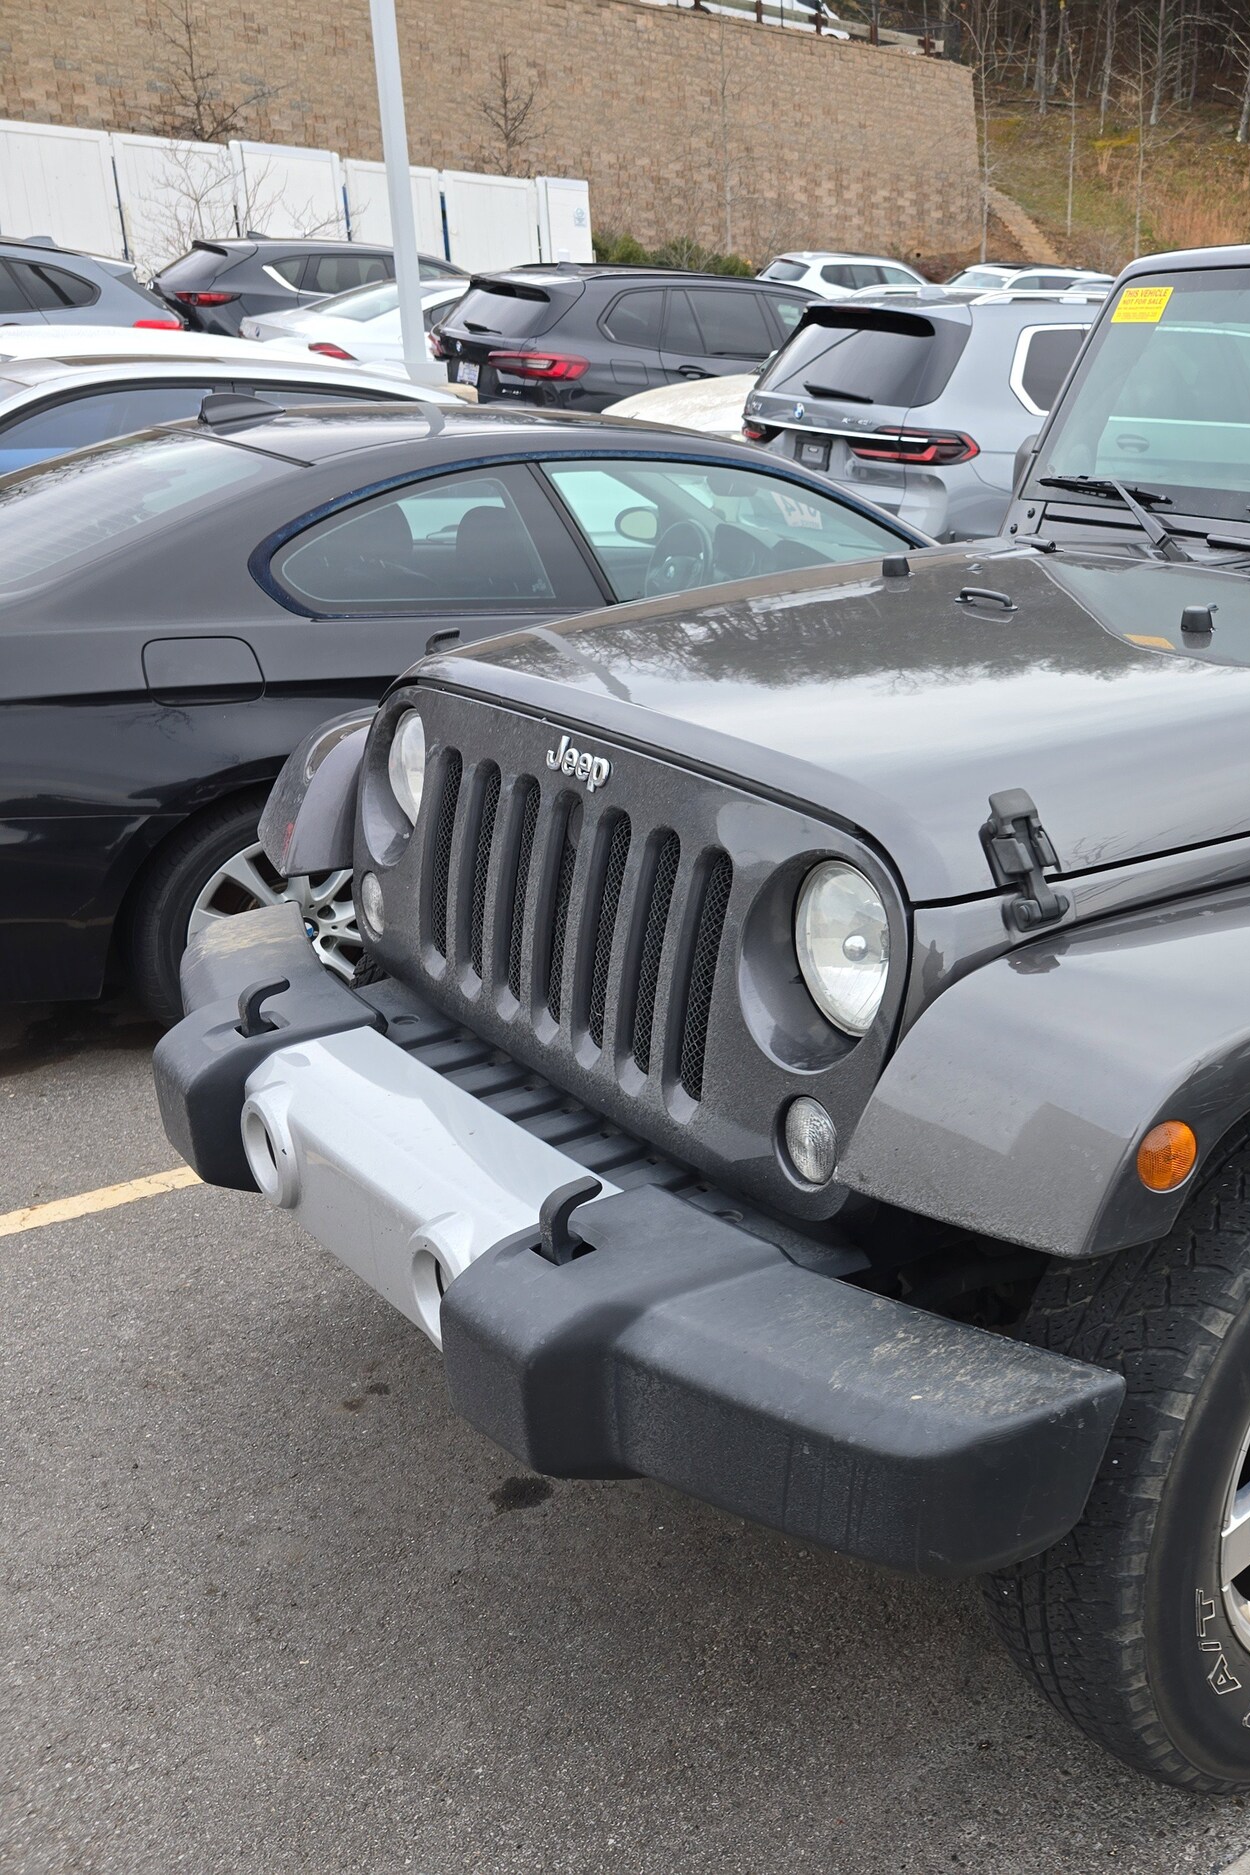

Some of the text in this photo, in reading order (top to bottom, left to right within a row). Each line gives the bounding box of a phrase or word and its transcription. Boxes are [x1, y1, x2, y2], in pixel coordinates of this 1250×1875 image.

[1124, 289, 1169, 298] THIS VEHICLE
[546, 735, 610, 793] Jeep
[1196, 1588, 1242, 1695] A/T
